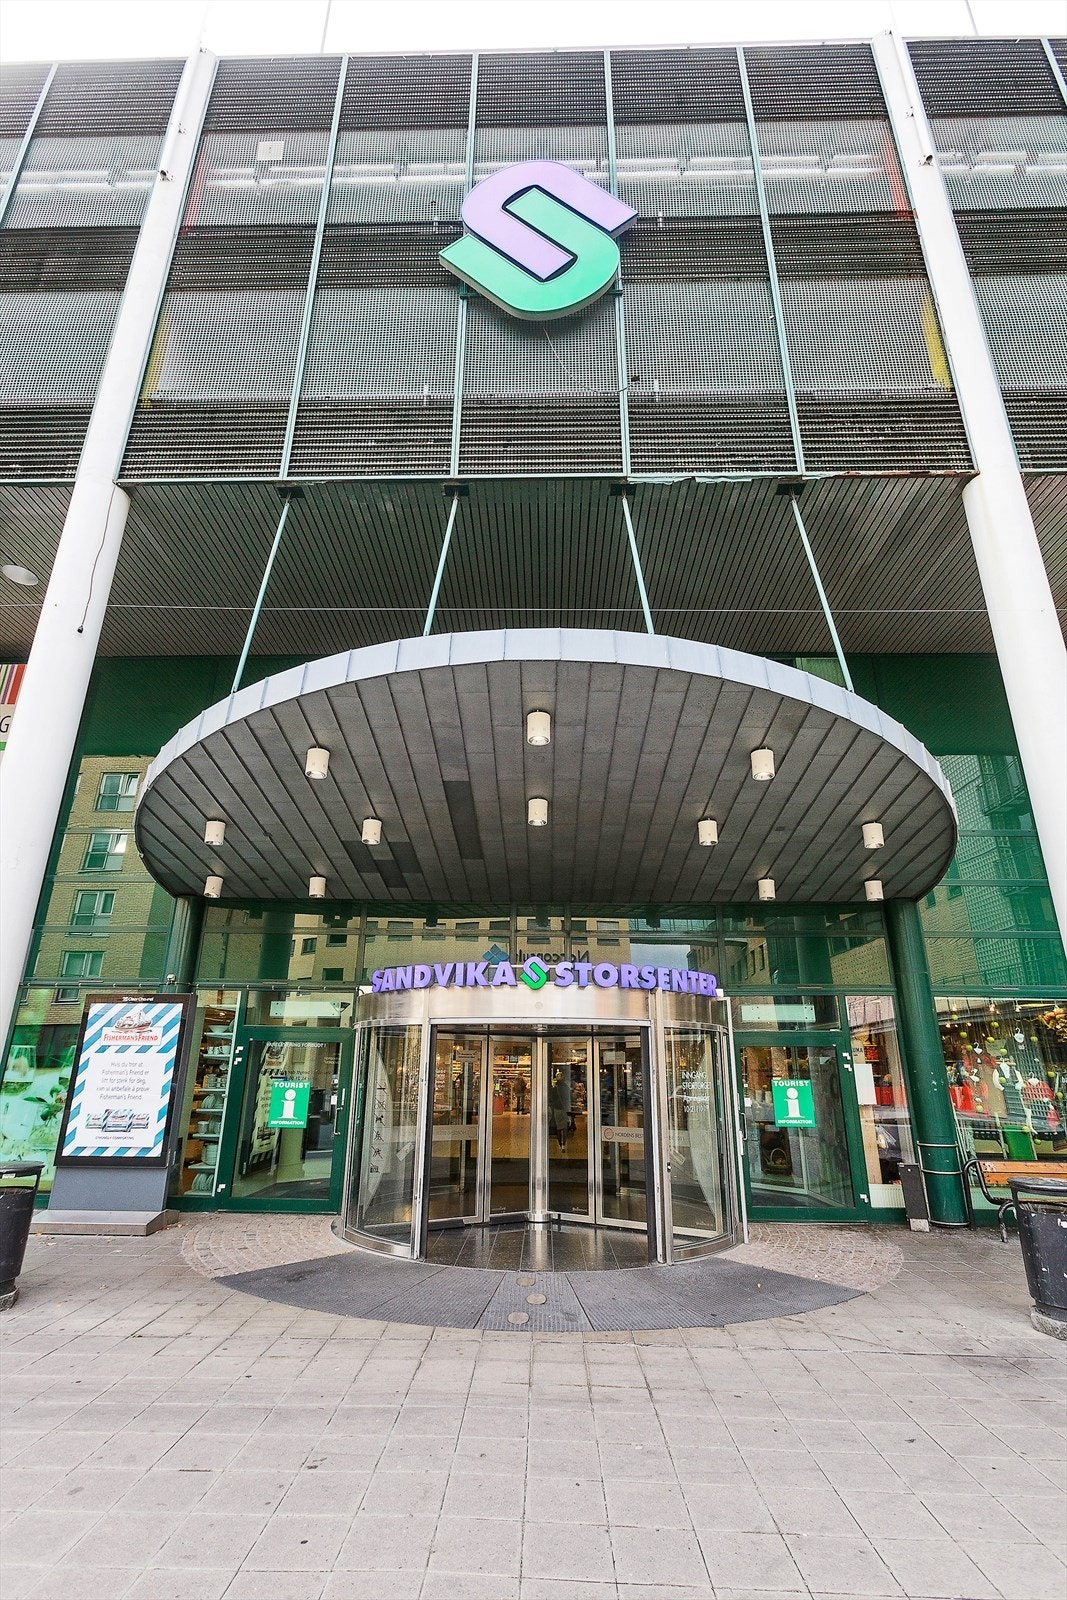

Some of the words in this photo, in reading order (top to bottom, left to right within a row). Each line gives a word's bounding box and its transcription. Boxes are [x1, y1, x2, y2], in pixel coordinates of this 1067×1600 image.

[372, 961, 517, 993] SANDVIKA
[554, 961, 718, 997] STORSENTER
[274, 1081, 309, 1089] TOURIST
